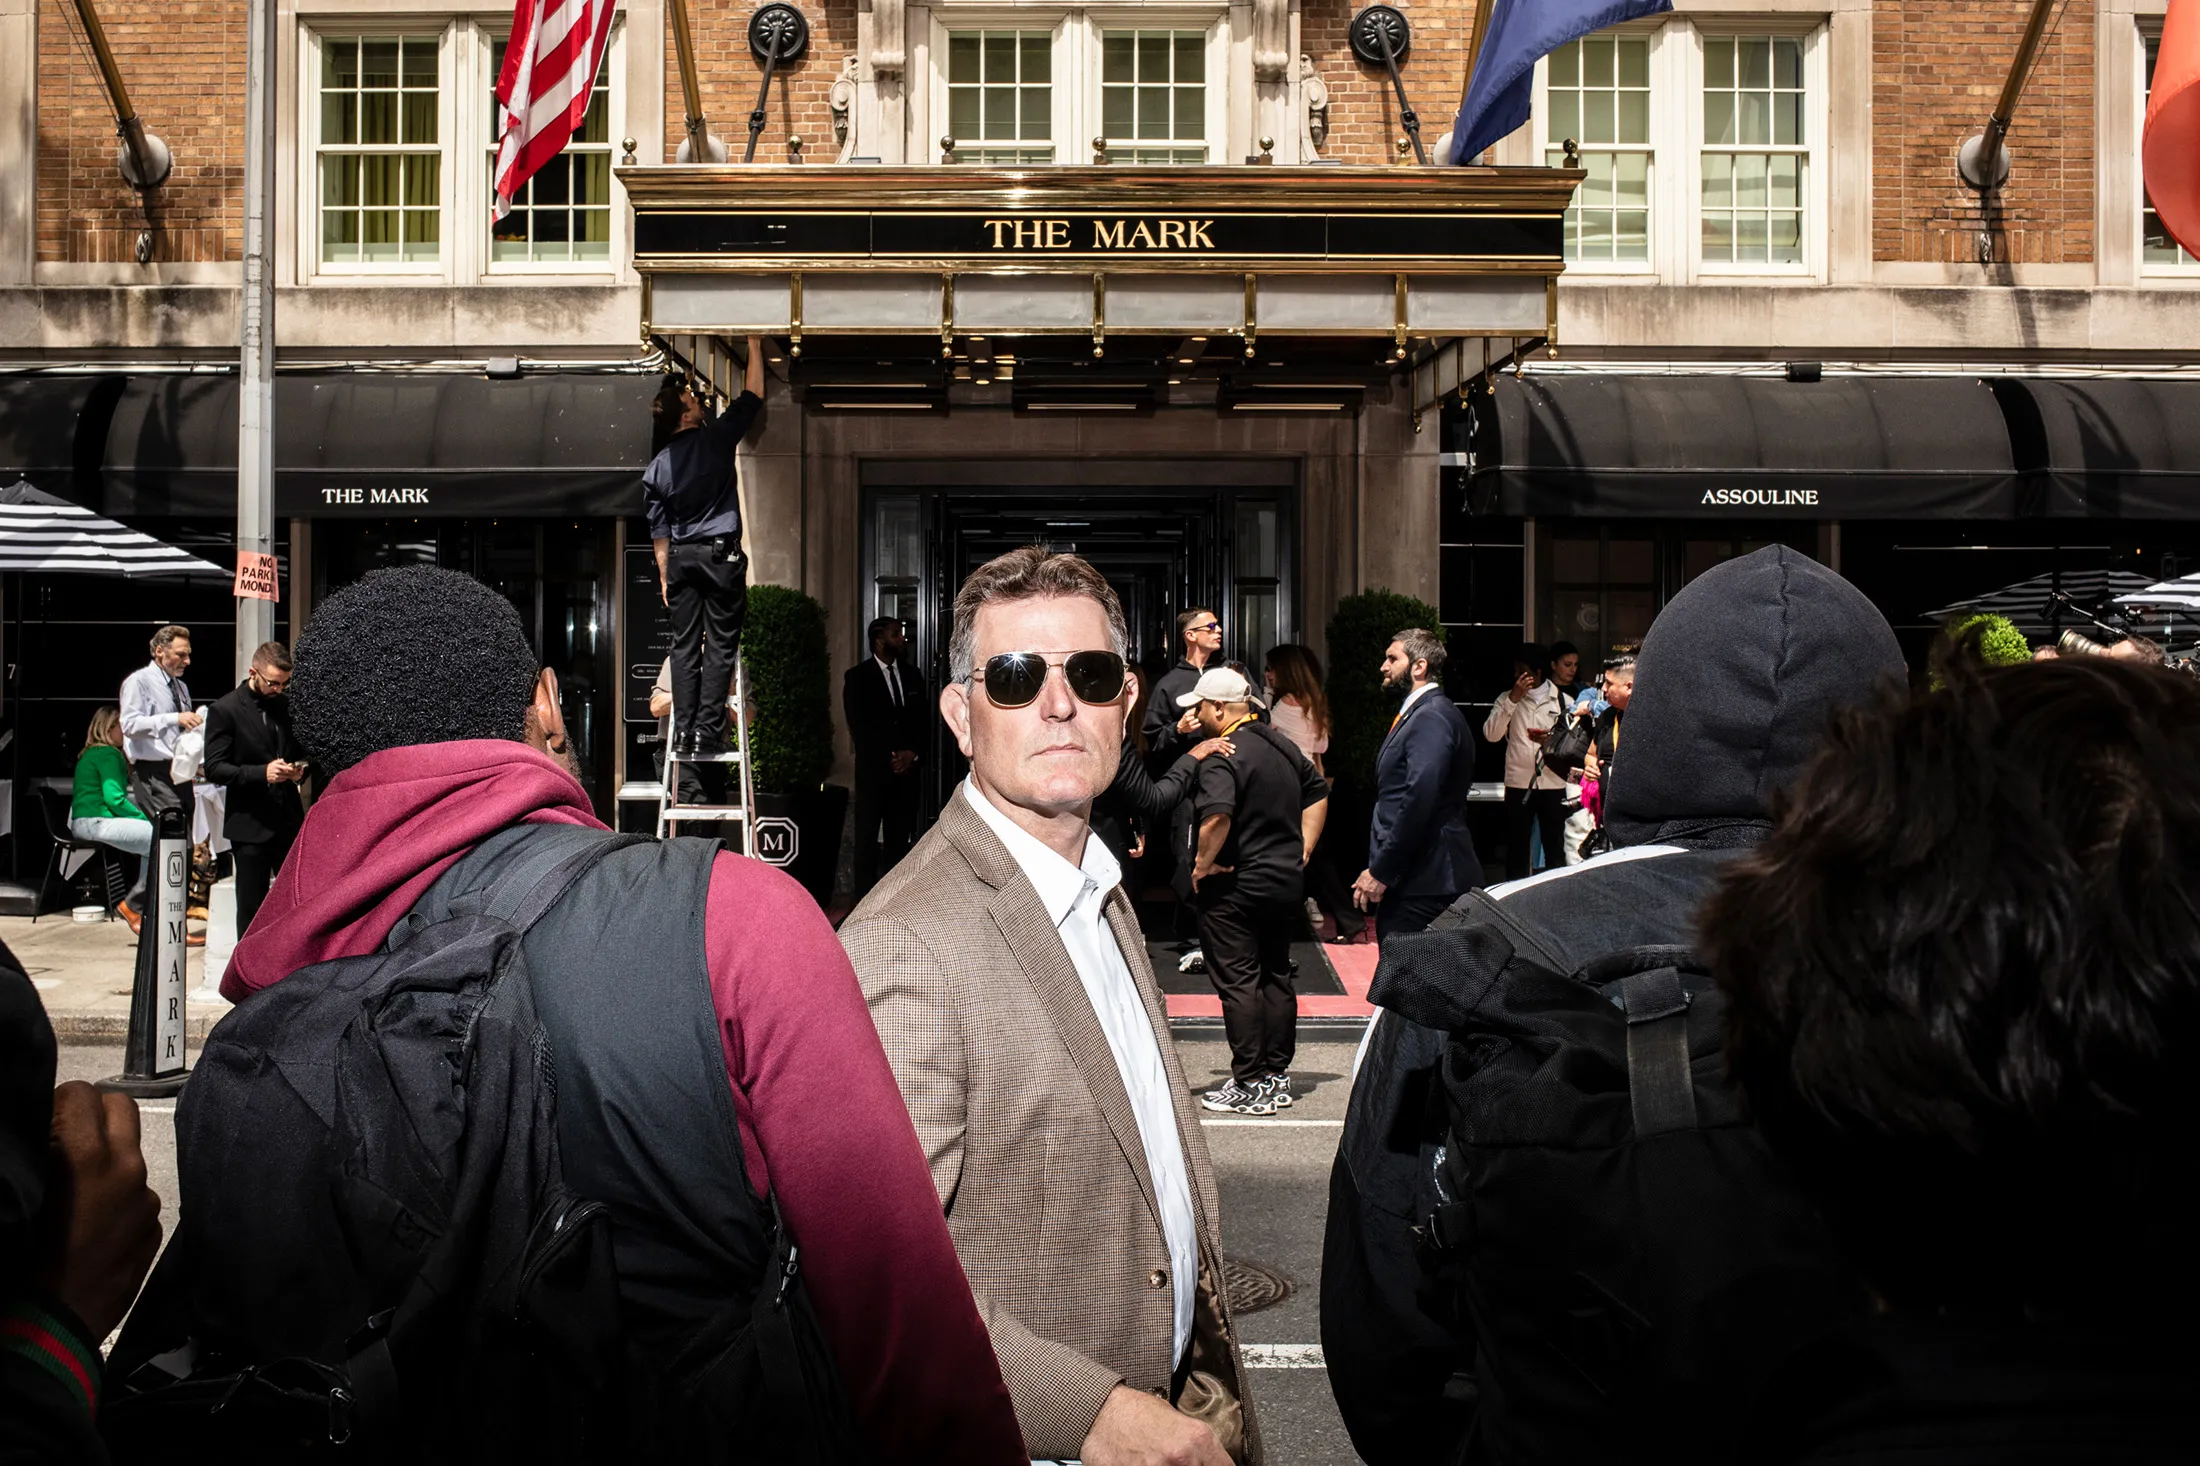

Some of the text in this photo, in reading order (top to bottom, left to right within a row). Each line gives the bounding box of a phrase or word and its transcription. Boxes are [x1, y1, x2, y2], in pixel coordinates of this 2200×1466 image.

[984, 220, 1215, 248] THE MARK
[321, 488, 429, 504] THE MARK
[1701, 489, 1819, 505] ASSOULINE
[260, 556, 273, 568] NO
[240, 580, 273, 593] MOND
[7, 663, 16, 680] 7
[763, 833, 784, 850] M
[172, 862, 181, 876] M
[168, 902, 183, 912] THE
[165, 921, 182, 1059] MARK
